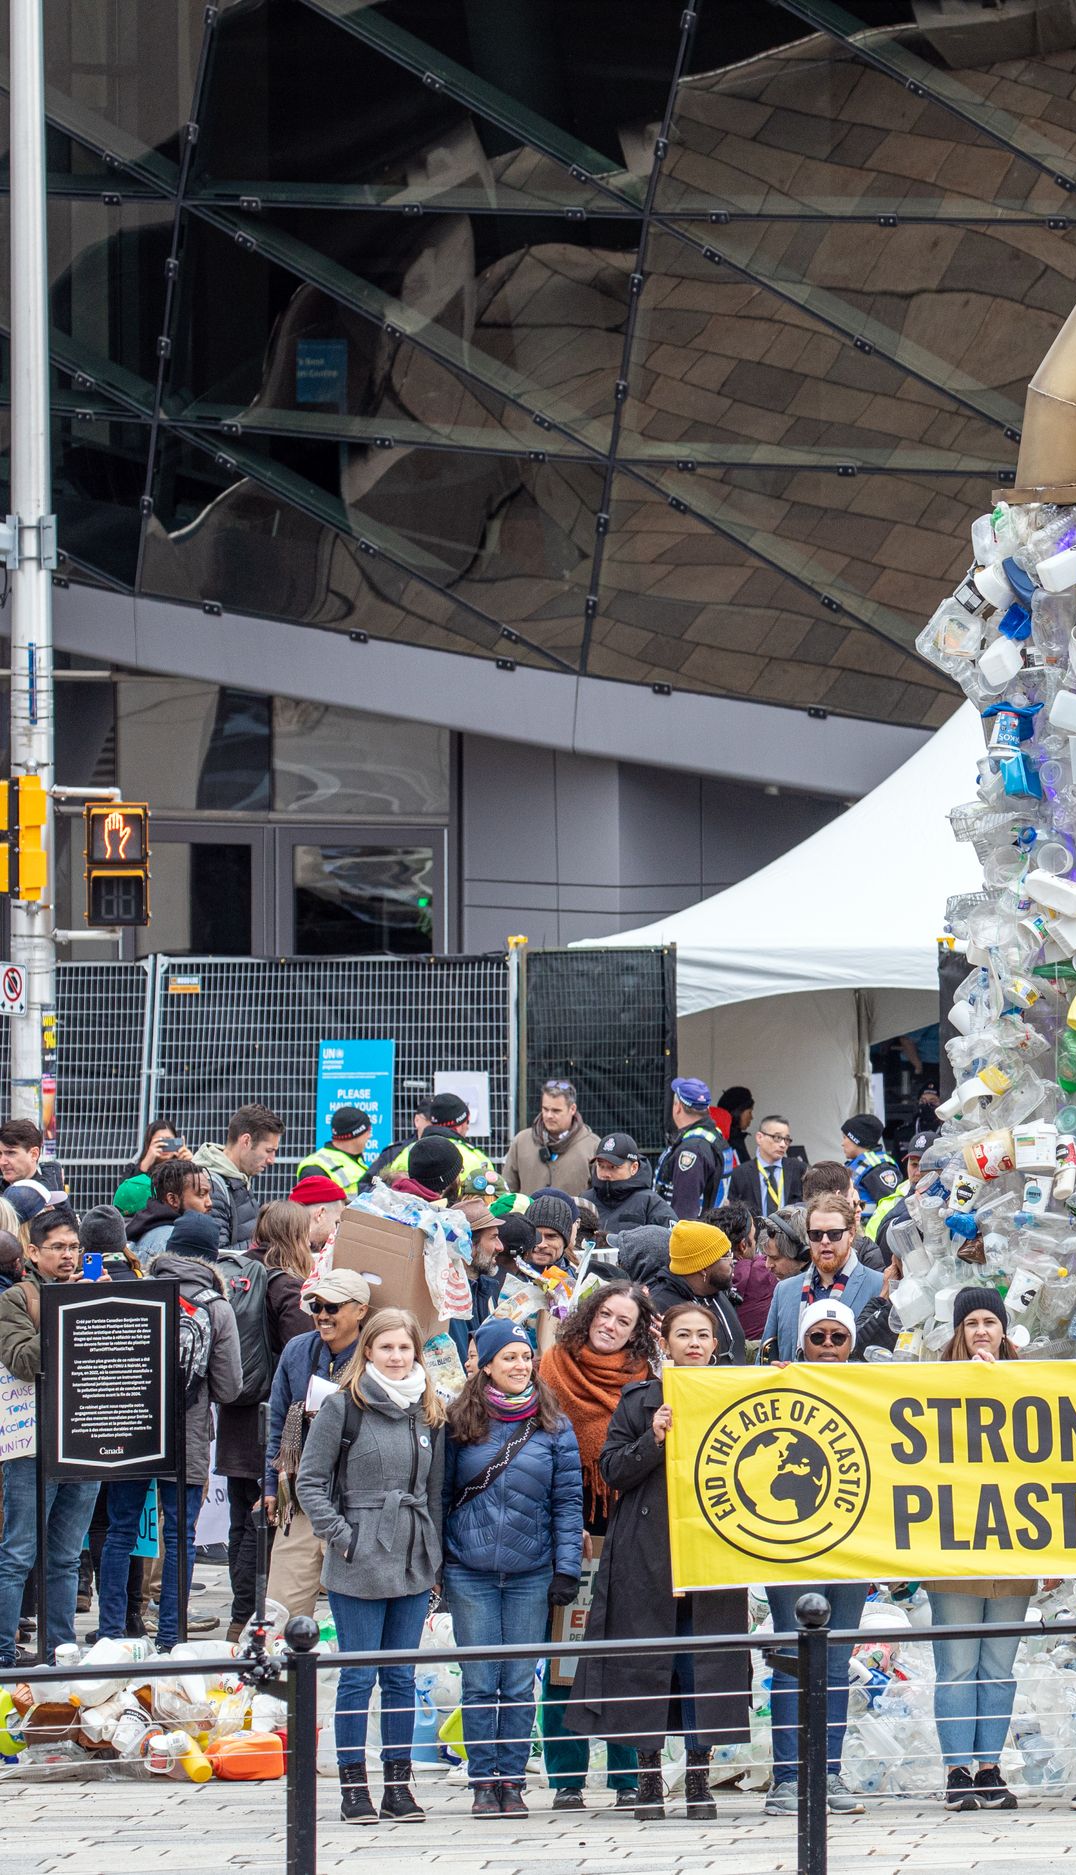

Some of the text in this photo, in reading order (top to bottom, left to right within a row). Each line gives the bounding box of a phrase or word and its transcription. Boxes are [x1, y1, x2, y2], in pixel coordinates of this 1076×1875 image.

[322, 1048, 336, 1059] UN
[337, 1088, 370, 1099] PLEASE
[354, 1102, 378, 1112] YOUR
[2, 1384, 35, 1401] CAUSE
[6, 1400, 36, 1415] TOXIC
[99, 1446, 124, 1455] Canada
[705, 1398, 861, 1522] END THE AGE OF PLASTIC
